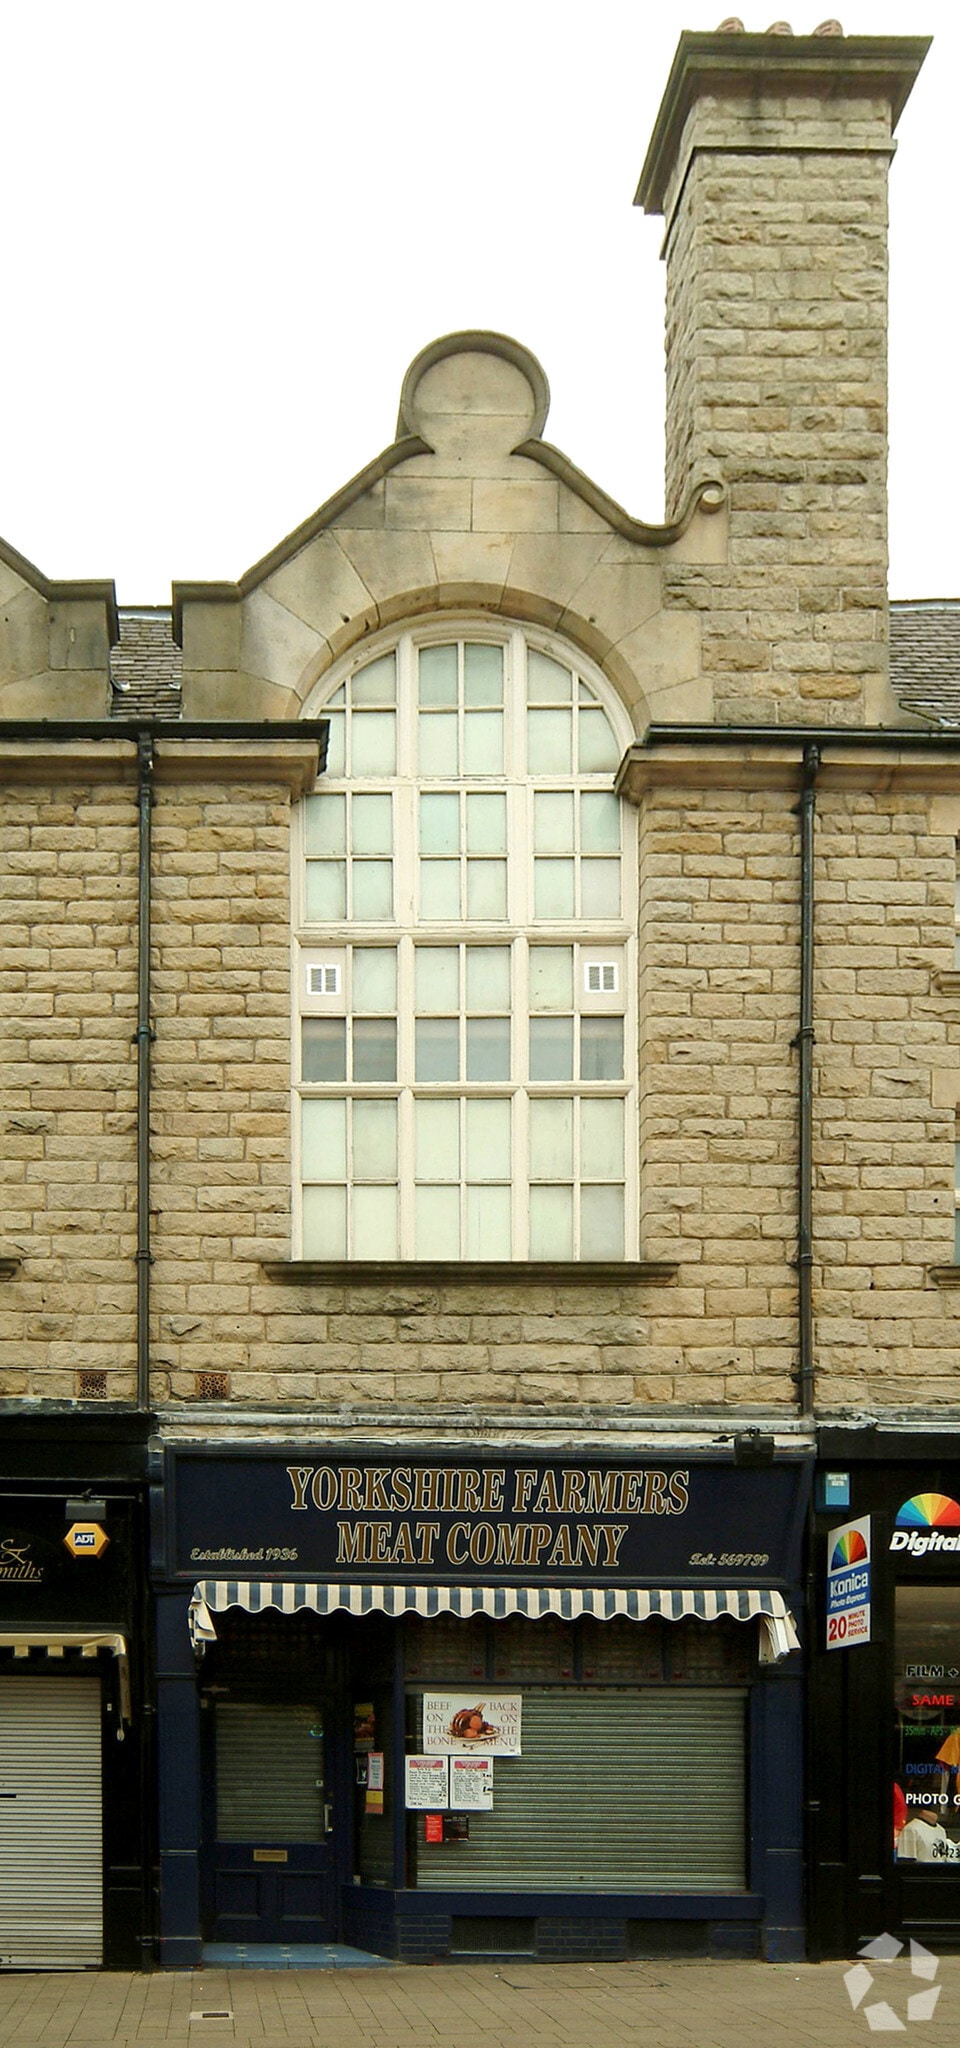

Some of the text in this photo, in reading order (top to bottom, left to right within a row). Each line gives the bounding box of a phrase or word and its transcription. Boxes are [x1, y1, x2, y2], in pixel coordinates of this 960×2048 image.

[286, 1466, 690, 1515] YORKSHIRE FARMERS
[75, 1534, 94, 1545] ADT
[336, 1521, 629, 1567] MEAT COMPANY
[190, 1547, 299, 1561] Established 1936
[688, 1552, 769, 1567] Tel: 569739
[829, 1571, 869, 1598] Konica
[828, 1615, 847, 1642] 20
[905, 1664, 944, 1678] FILM
[426, 1701, 451, 1711] BEEF
[911, 1694, 955, 1706] SAME
[489, 1702, 517, 1711] BACK
[426, 1713, 443, 1723] ON
[500, 1714, 517, 1723] ON
[426, 1725, 449, 1735] THE
[426, 1736, 457, 1746] BONE
[483, 1738, 517, 1747] MENU
[905, 1763, 945, 1775] DIGITAL
[905, 1793, 949, 1805] PHOTO
